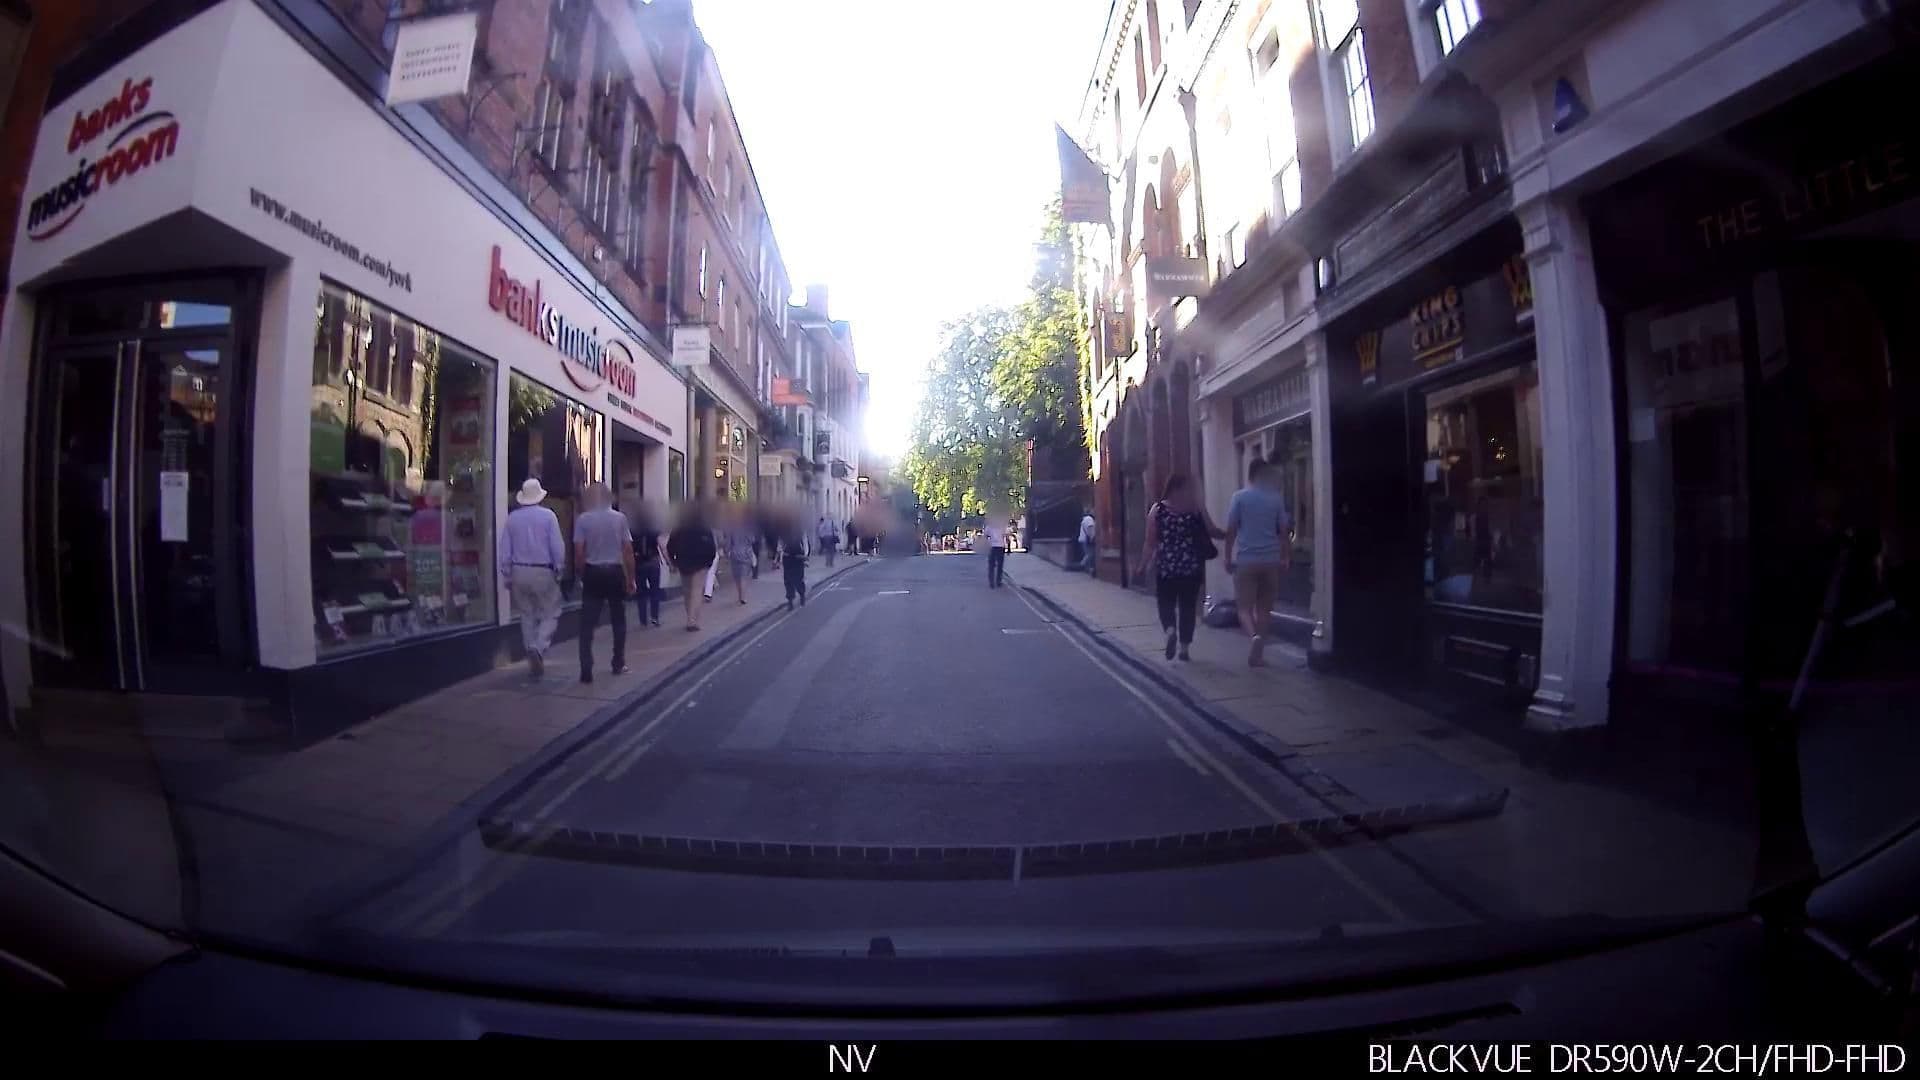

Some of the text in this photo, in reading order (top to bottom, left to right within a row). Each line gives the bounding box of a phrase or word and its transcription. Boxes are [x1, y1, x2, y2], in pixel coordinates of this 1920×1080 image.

[67, 77, 154, 154] banks
[27, 121, 180, 231] musicroom
[1696, 143, 1909, 248] THE LITTLE
[249, 186, 413, 293] www.musicroom.com/york
